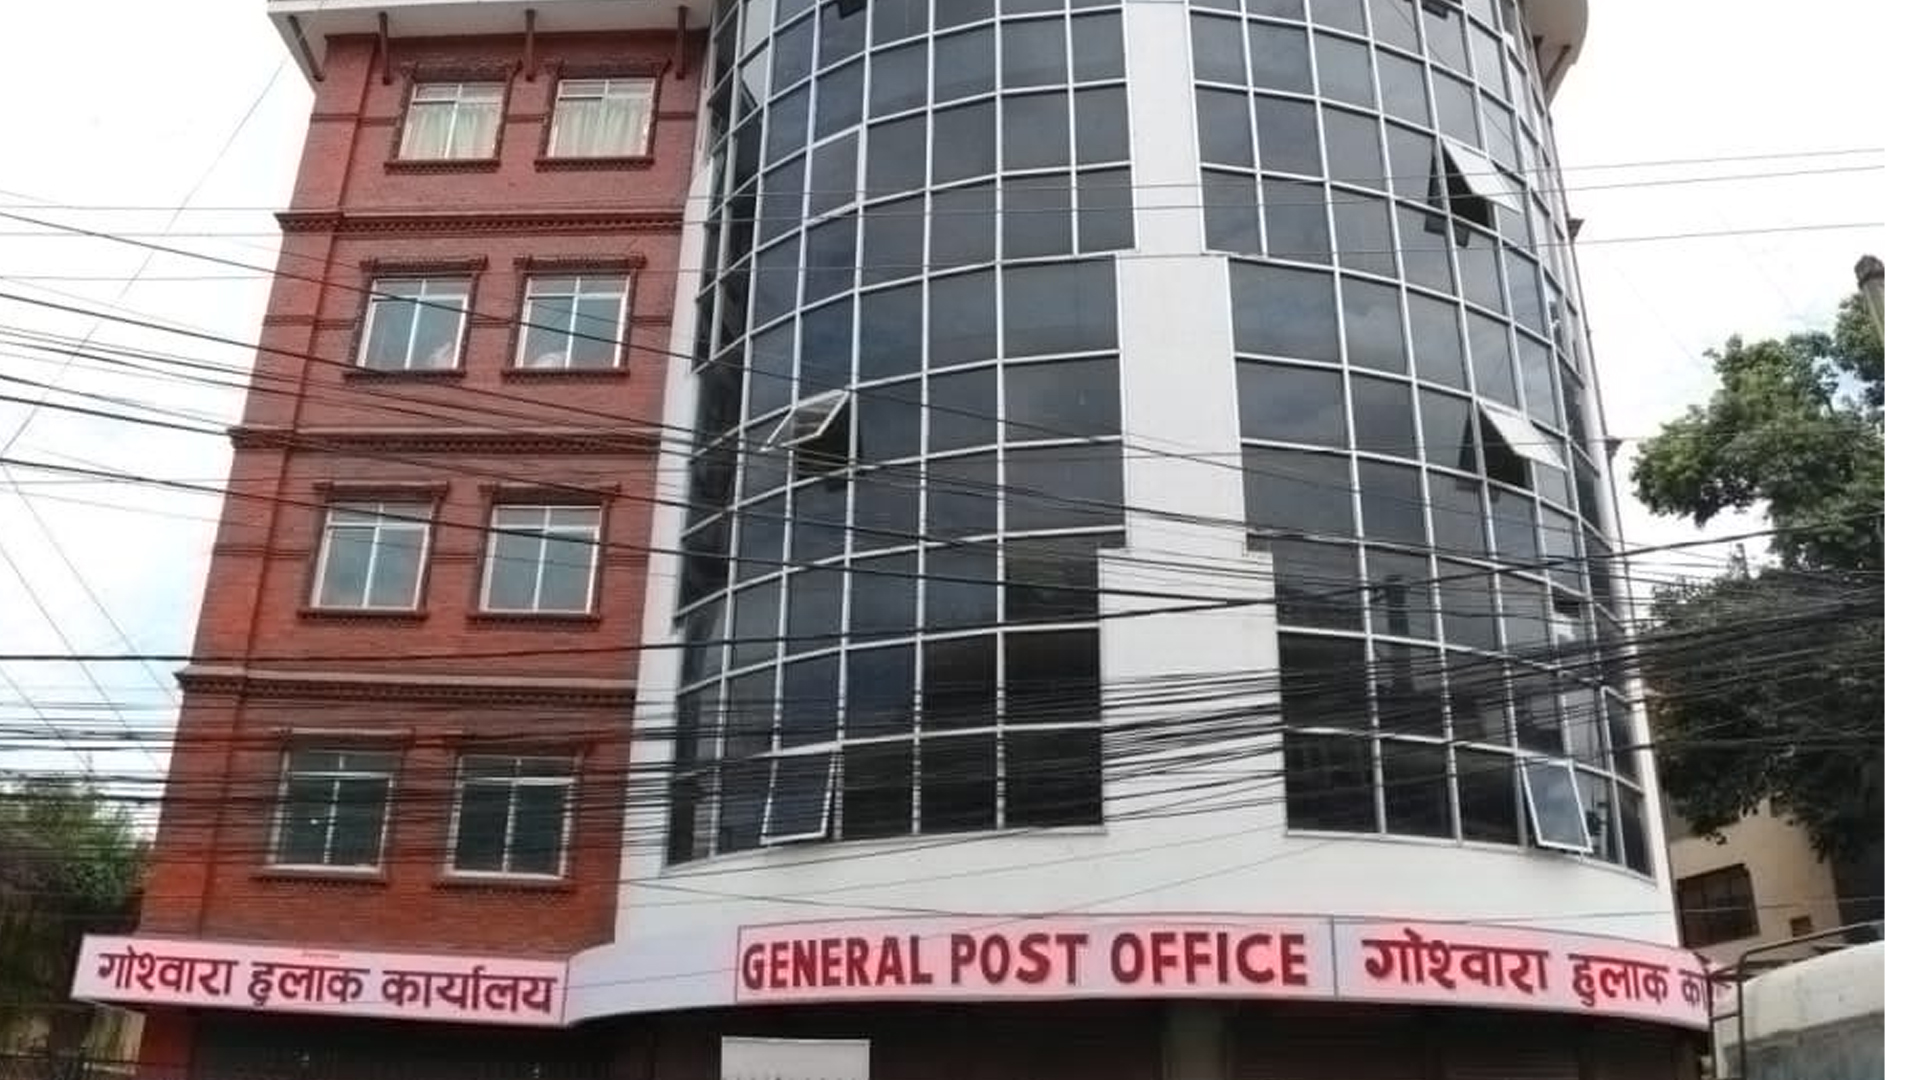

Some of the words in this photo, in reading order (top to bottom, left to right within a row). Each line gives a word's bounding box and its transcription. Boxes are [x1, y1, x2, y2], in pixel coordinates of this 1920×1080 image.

[99, 945, 239, 995] गोश्वारा
[247, 960, 369, 1007] हुलाक
[382, 964, 558, 1014] कार्यालय
[742, 937, 933, 990] GENERAL
[951, 933, 1088, 985] POST
[1110, 931, 1308, 985] OFFICE
[1362, 928, 1549, 993] गोश्वारा
[1568, 953, 1670, 1007] हुलाक
